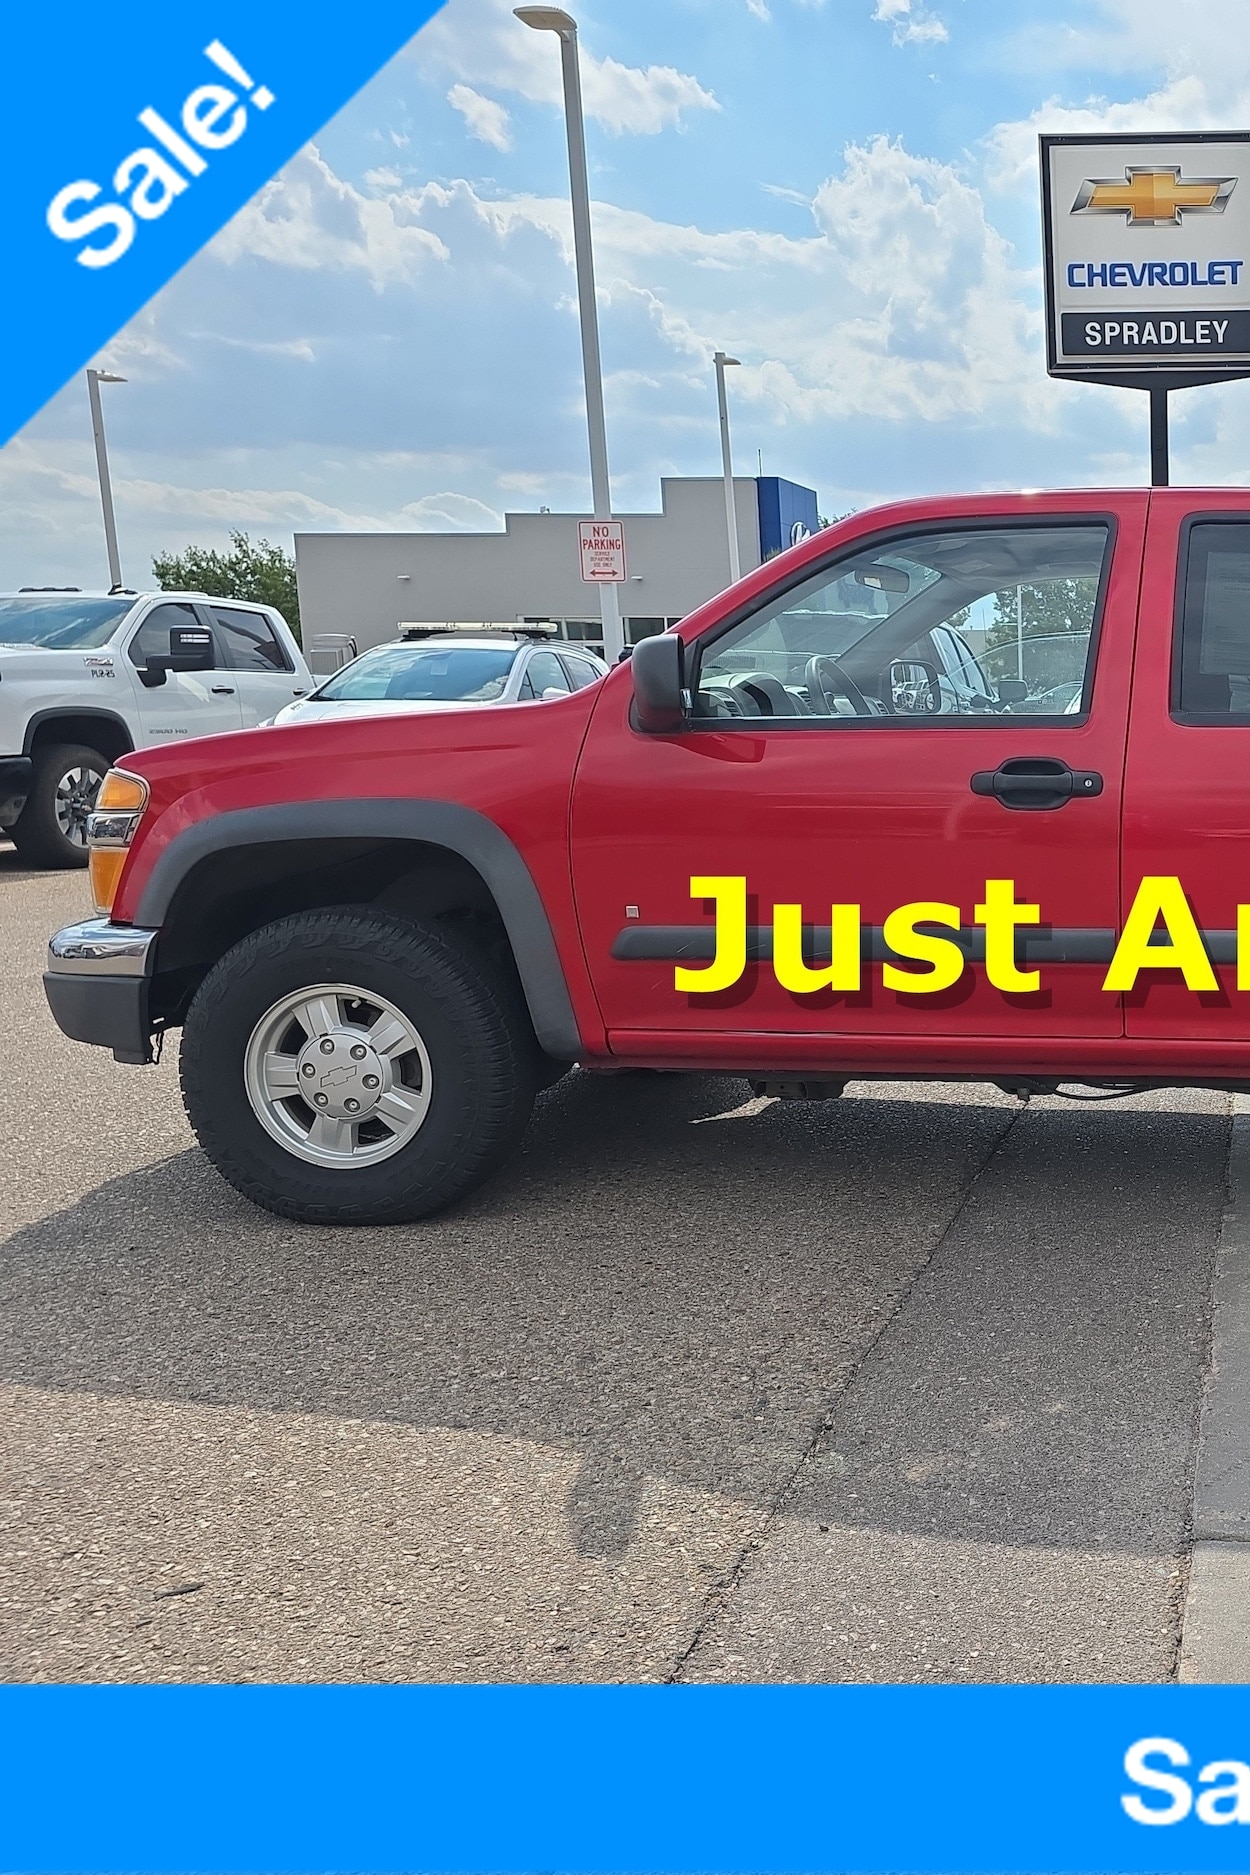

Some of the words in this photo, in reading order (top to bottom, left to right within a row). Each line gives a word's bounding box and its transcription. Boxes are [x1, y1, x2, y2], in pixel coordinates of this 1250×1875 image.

[1066, 260, 1244, 288] CHEVROLET
[1084, 319, 1229, 346] SPRADLEY
[592, 526, 609, 538] NO
[582, 539, 621, 550] PARKING
